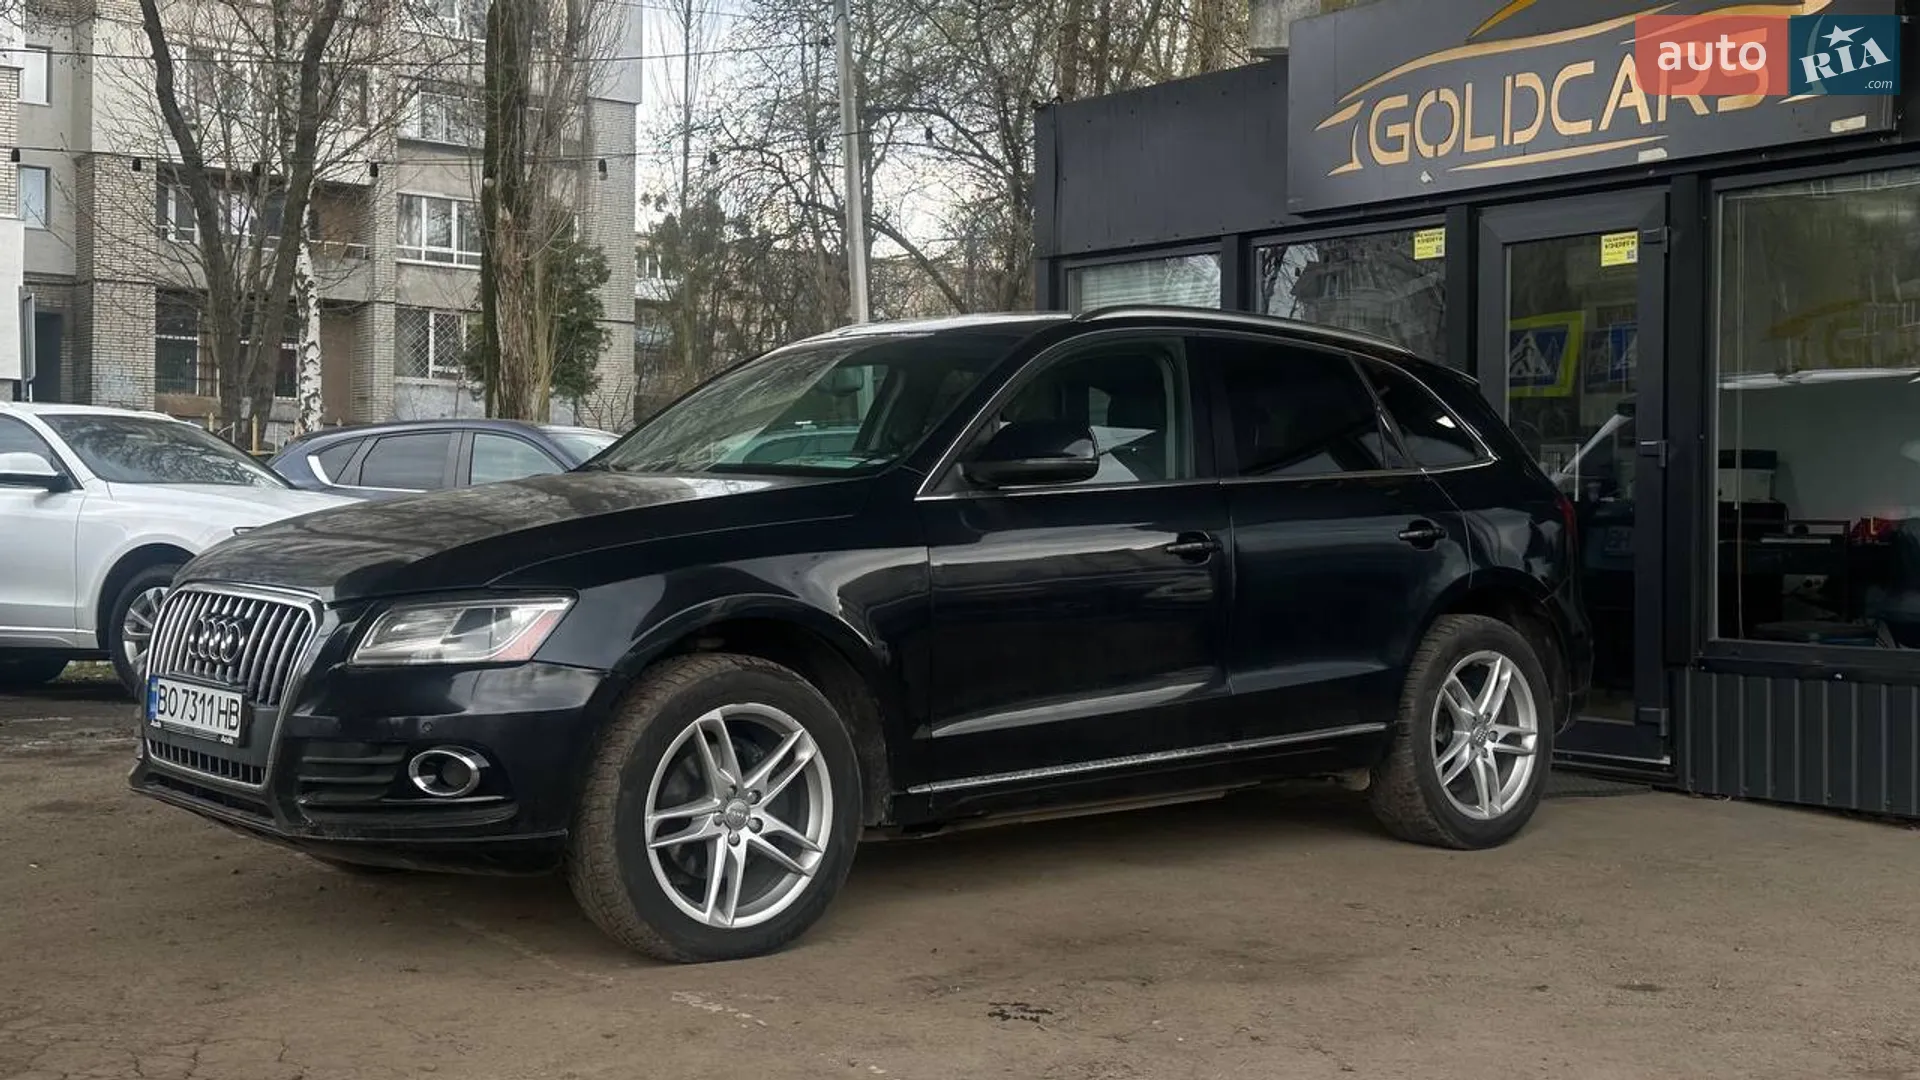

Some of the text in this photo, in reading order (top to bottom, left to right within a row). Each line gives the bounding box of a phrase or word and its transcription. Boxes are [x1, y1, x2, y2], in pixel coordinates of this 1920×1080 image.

[158, 684, 240, 731] BO 7311 HB
